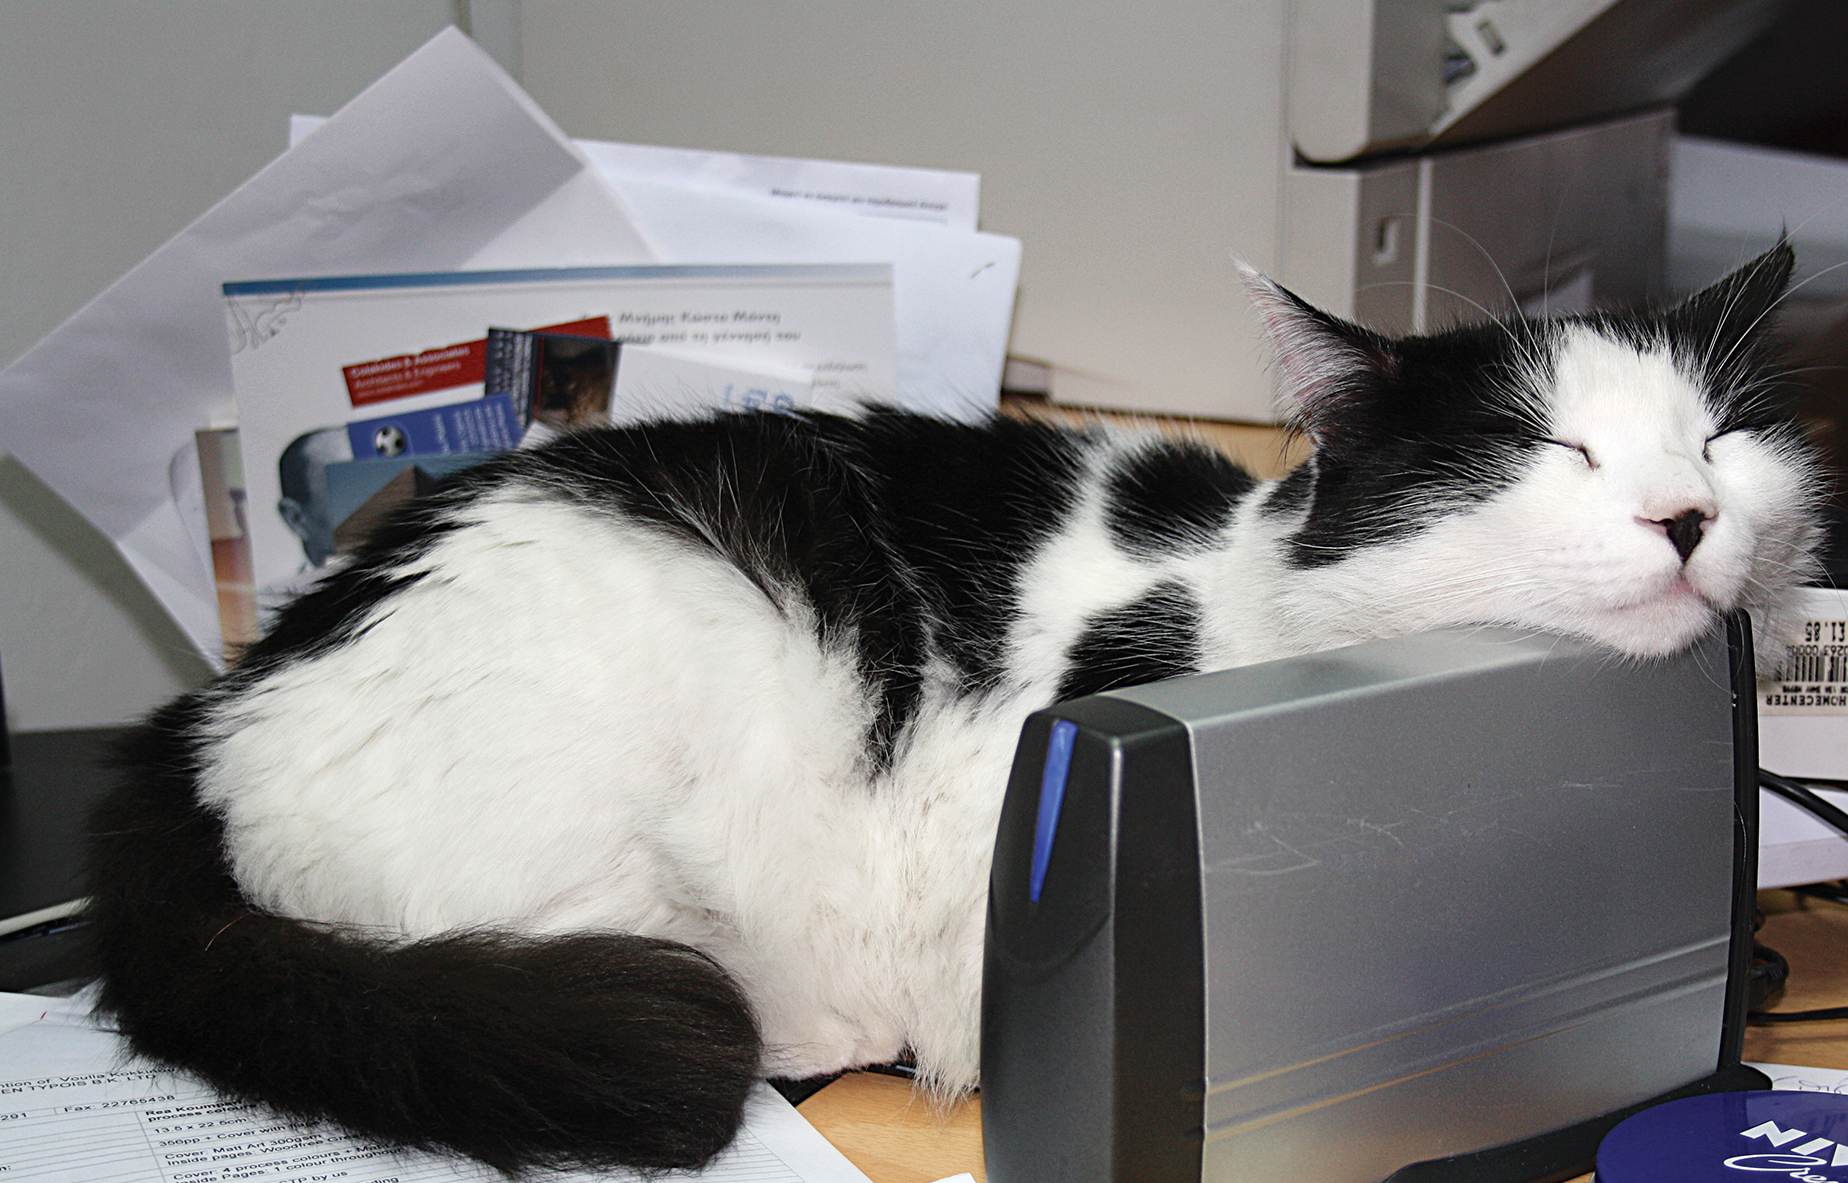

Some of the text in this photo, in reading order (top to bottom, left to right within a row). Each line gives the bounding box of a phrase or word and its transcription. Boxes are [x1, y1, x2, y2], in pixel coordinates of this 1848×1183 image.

[1766, 694, 1847, 707] HOMECENTER
[30, 1081, 87, 1091] TYPOIS
[127, 1074, 157, 1082] LTD
[64, 1104, 96, 1113] Fax:
[145, 1108, 171, 1116] Rea
[148, 1111, 202, 1123] process
[217, 1130, 255, 1140] Cover
[259, 1124, 286, 1134] with
[164, 1149, 209, 1160] Cover:
[247, 1141, 265, 1150] Art
[167, 1155, 208, 1166] Inside
[212, 1150, 256, 1162] pages:
[260, 1139, 324, 1154] Woodfree
[173, 1169, 218, 1180] Cover:
[235, 1159, 288, 1171] process
[292, 1151, 340, 1163] colours
[221, 1169, 270, 1181] Pages:
[286, 1159, 327, 1171] colour
[330, 1149, 402, 1163] throughout
